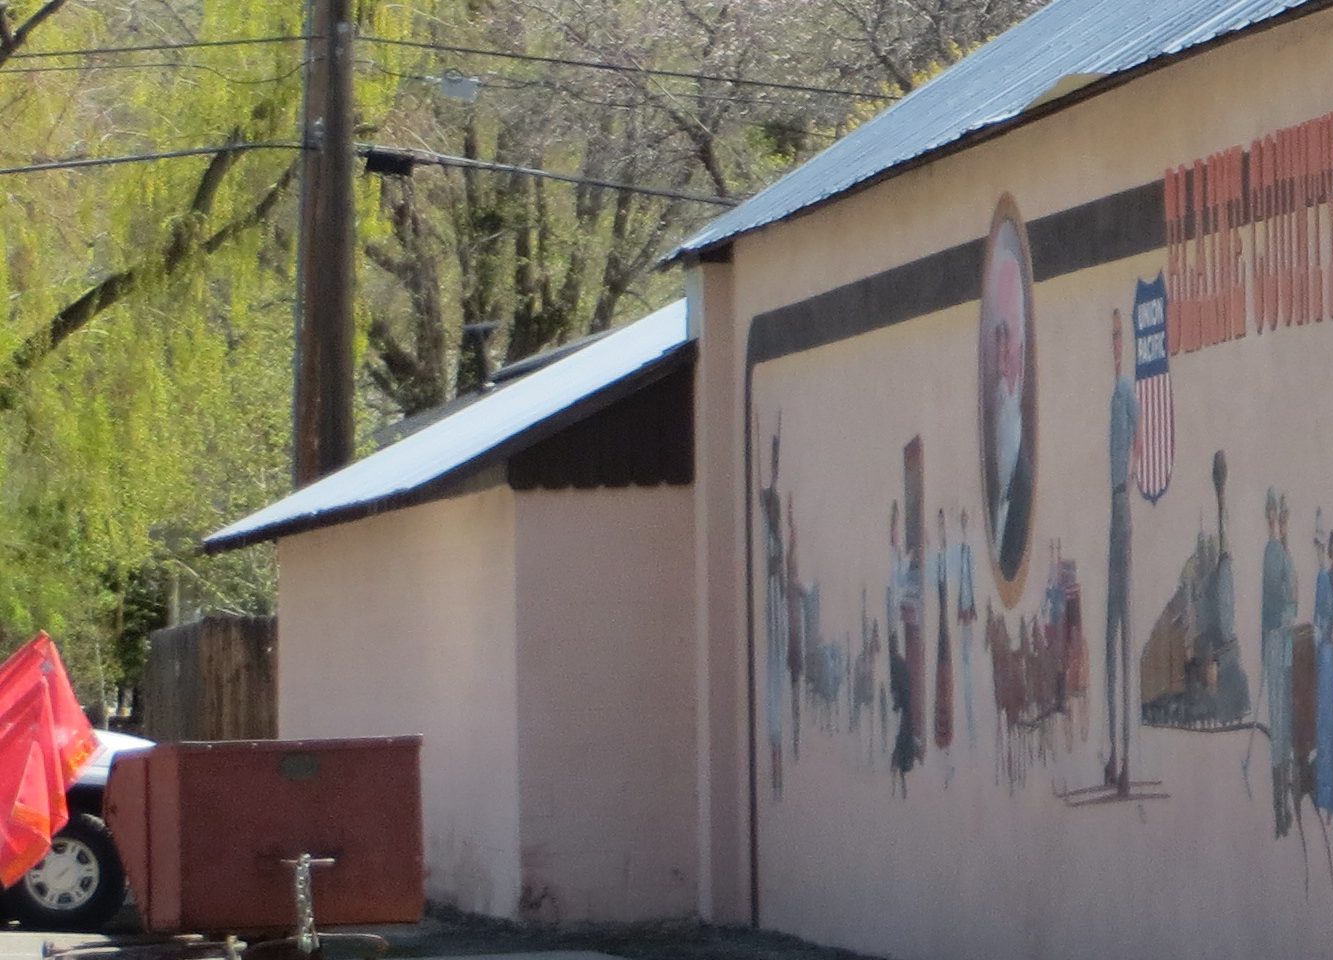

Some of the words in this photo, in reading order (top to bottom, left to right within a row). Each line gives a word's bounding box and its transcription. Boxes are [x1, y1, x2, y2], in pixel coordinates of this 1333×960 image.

[1164, 145, 1246, 356] BLAINE
[1137, 297, 1164, 330] UNION
[1137, 331, 1166, 365] PACIFIC
